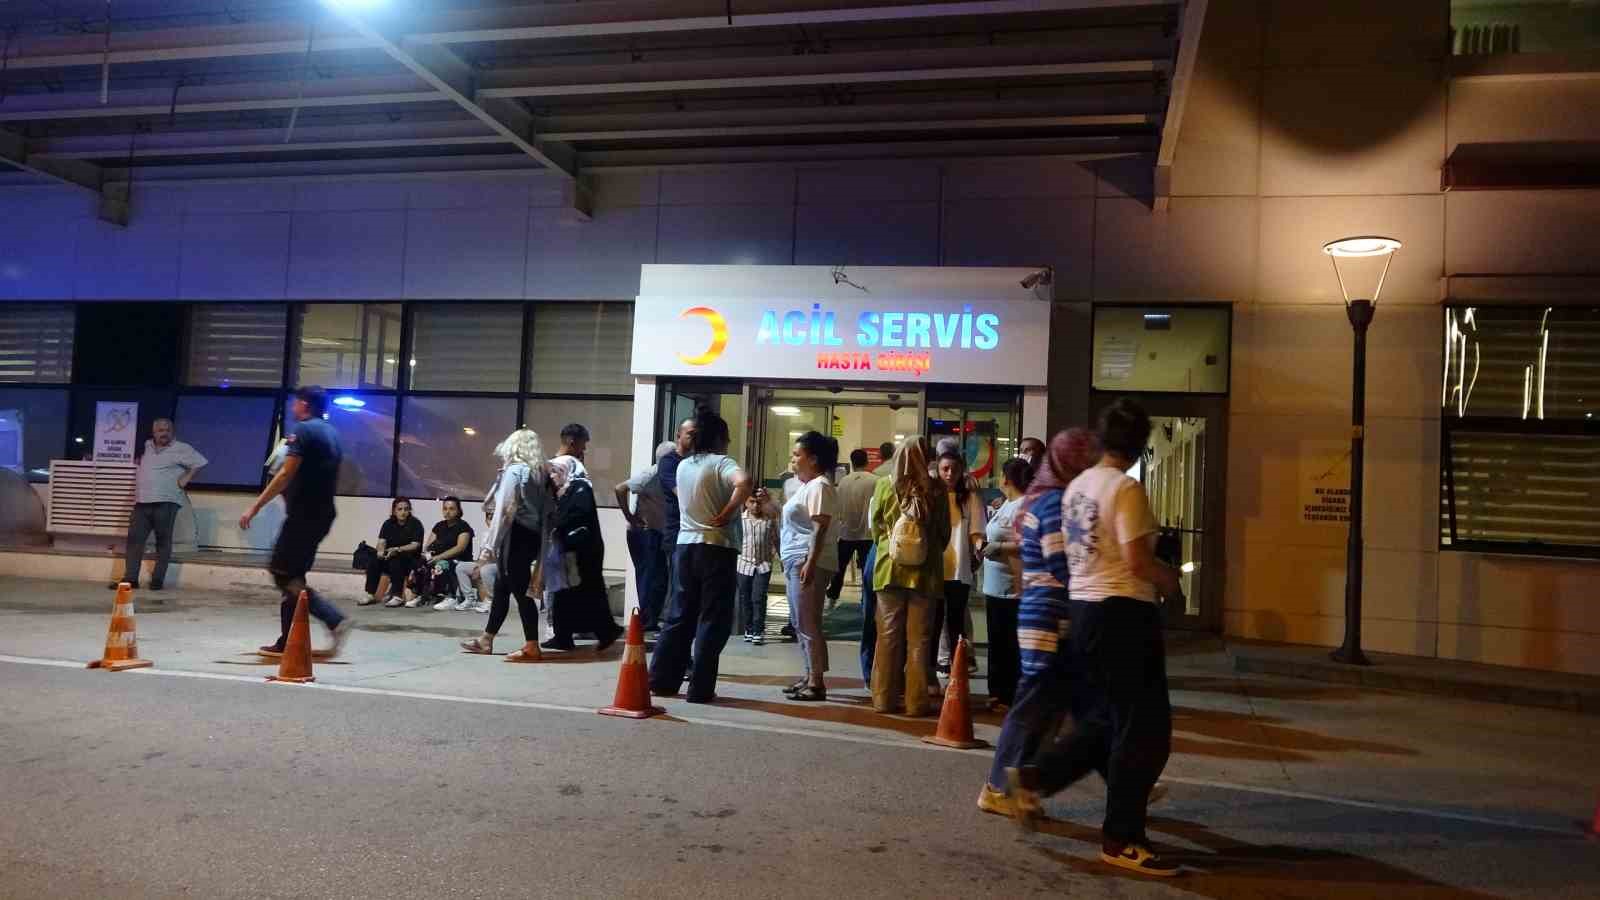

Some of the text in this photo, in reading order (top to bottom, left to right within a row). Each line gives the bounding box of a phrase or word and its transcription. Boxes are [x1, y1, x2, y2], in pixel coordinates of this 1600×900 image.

[757, 303, 1000, 350] ACİL SERVİS
[817, 351, 931, 375] HASTA GİRİŞİ
